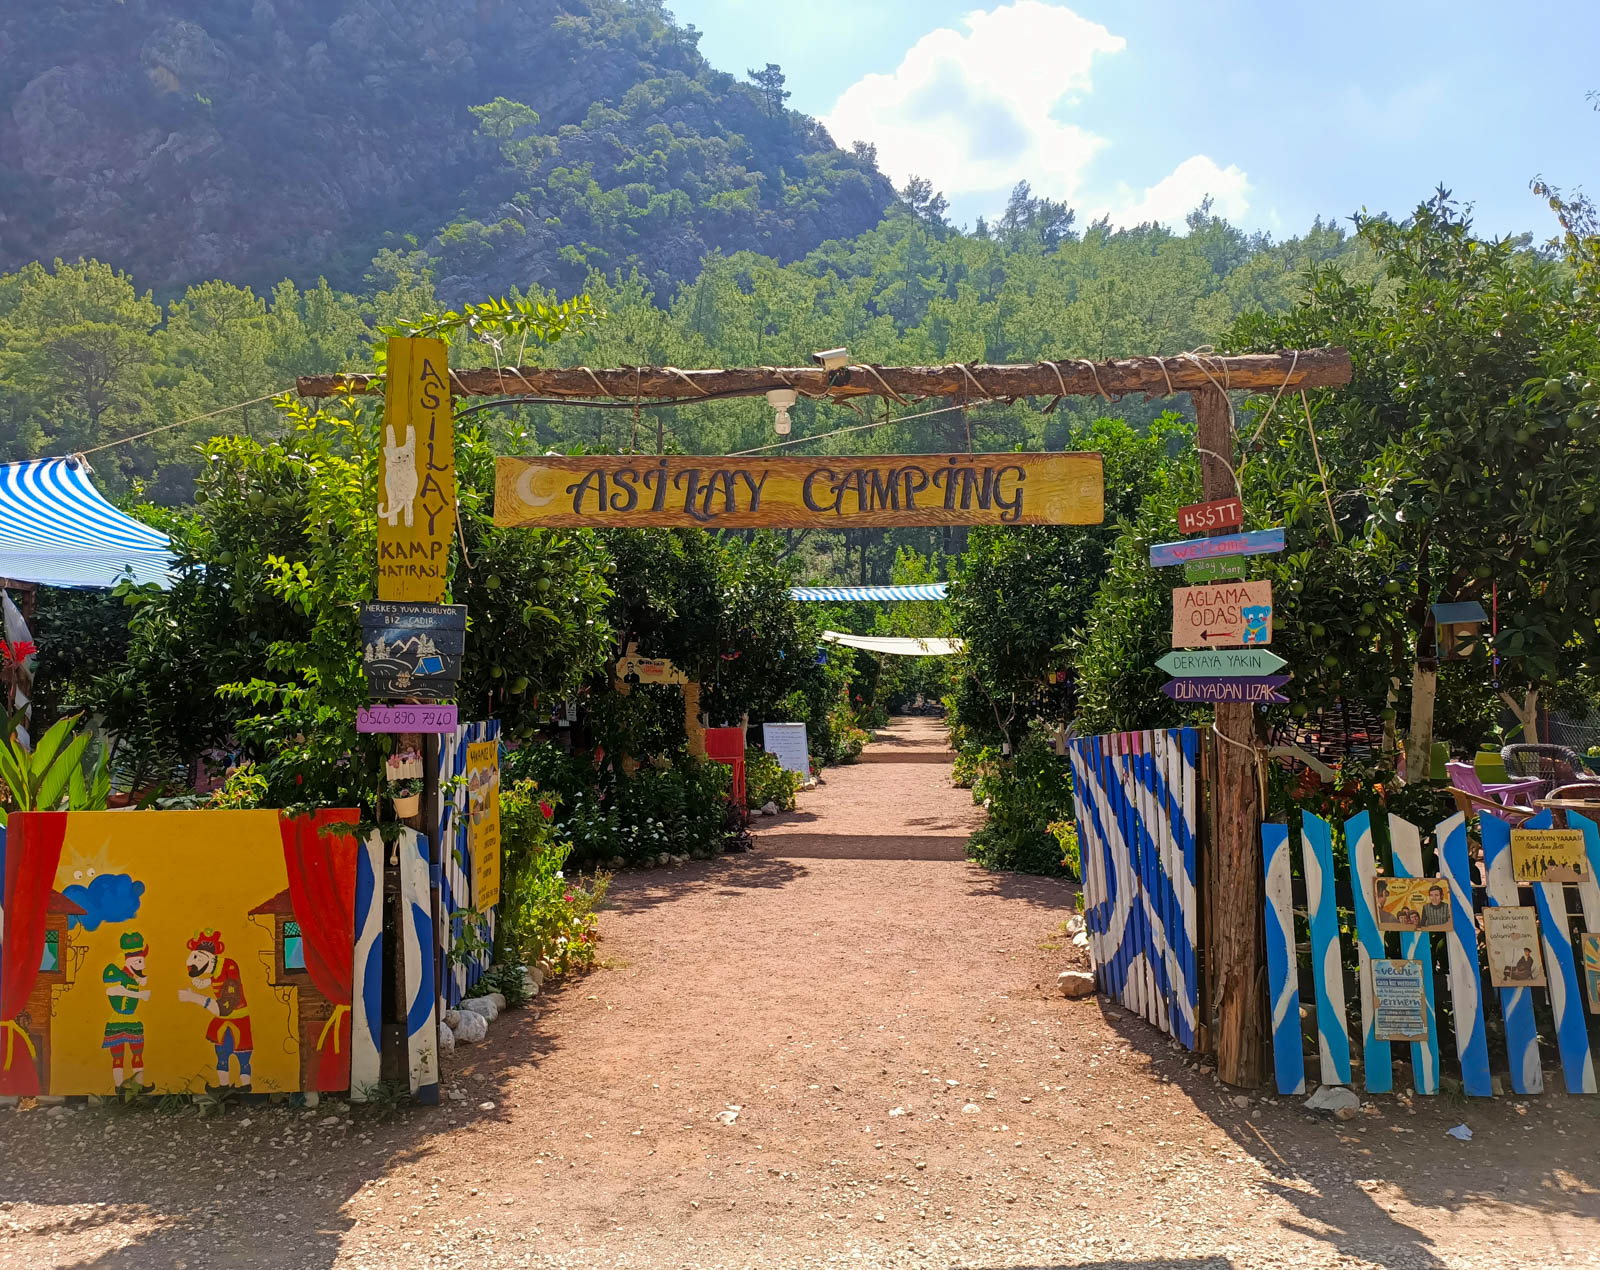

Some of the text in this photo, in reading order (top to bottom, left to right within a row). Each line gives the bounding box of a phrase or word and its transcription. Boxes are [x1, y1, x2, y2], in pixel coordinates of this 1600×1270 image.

[380, 541, 443, 561] KAMP
[378, 564, 439, 579] HATIRASI
[365, 604, 457, 616] HERKES YUVA KURUYOR
[1173, 655, 1262, 669] DERYAYA YAKIN
[1175, 681, 1276, 701] DÜNYADAN UZAK
[360, 711, 452, 726] 0546 890 7940
